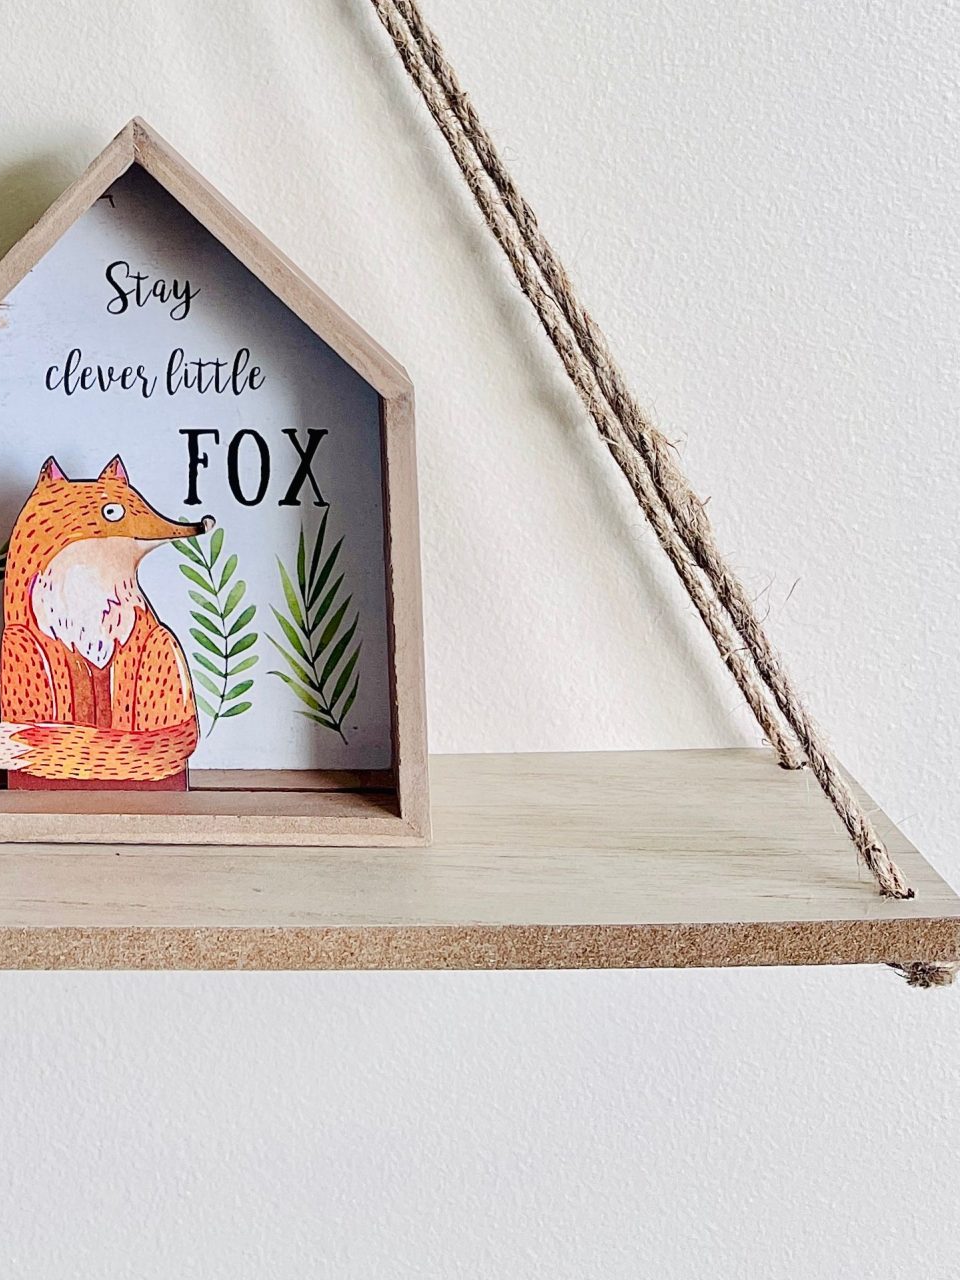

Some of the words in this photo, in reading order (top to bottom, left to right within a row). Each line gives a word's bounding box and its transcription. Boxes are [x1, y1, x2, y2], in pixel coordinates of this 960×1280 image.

[105, 260, 201, 321] Stay
[45, 348, 157, 398] clever
[165, 347, 266, 396] little
[178, 428, 330, 507] FOX
